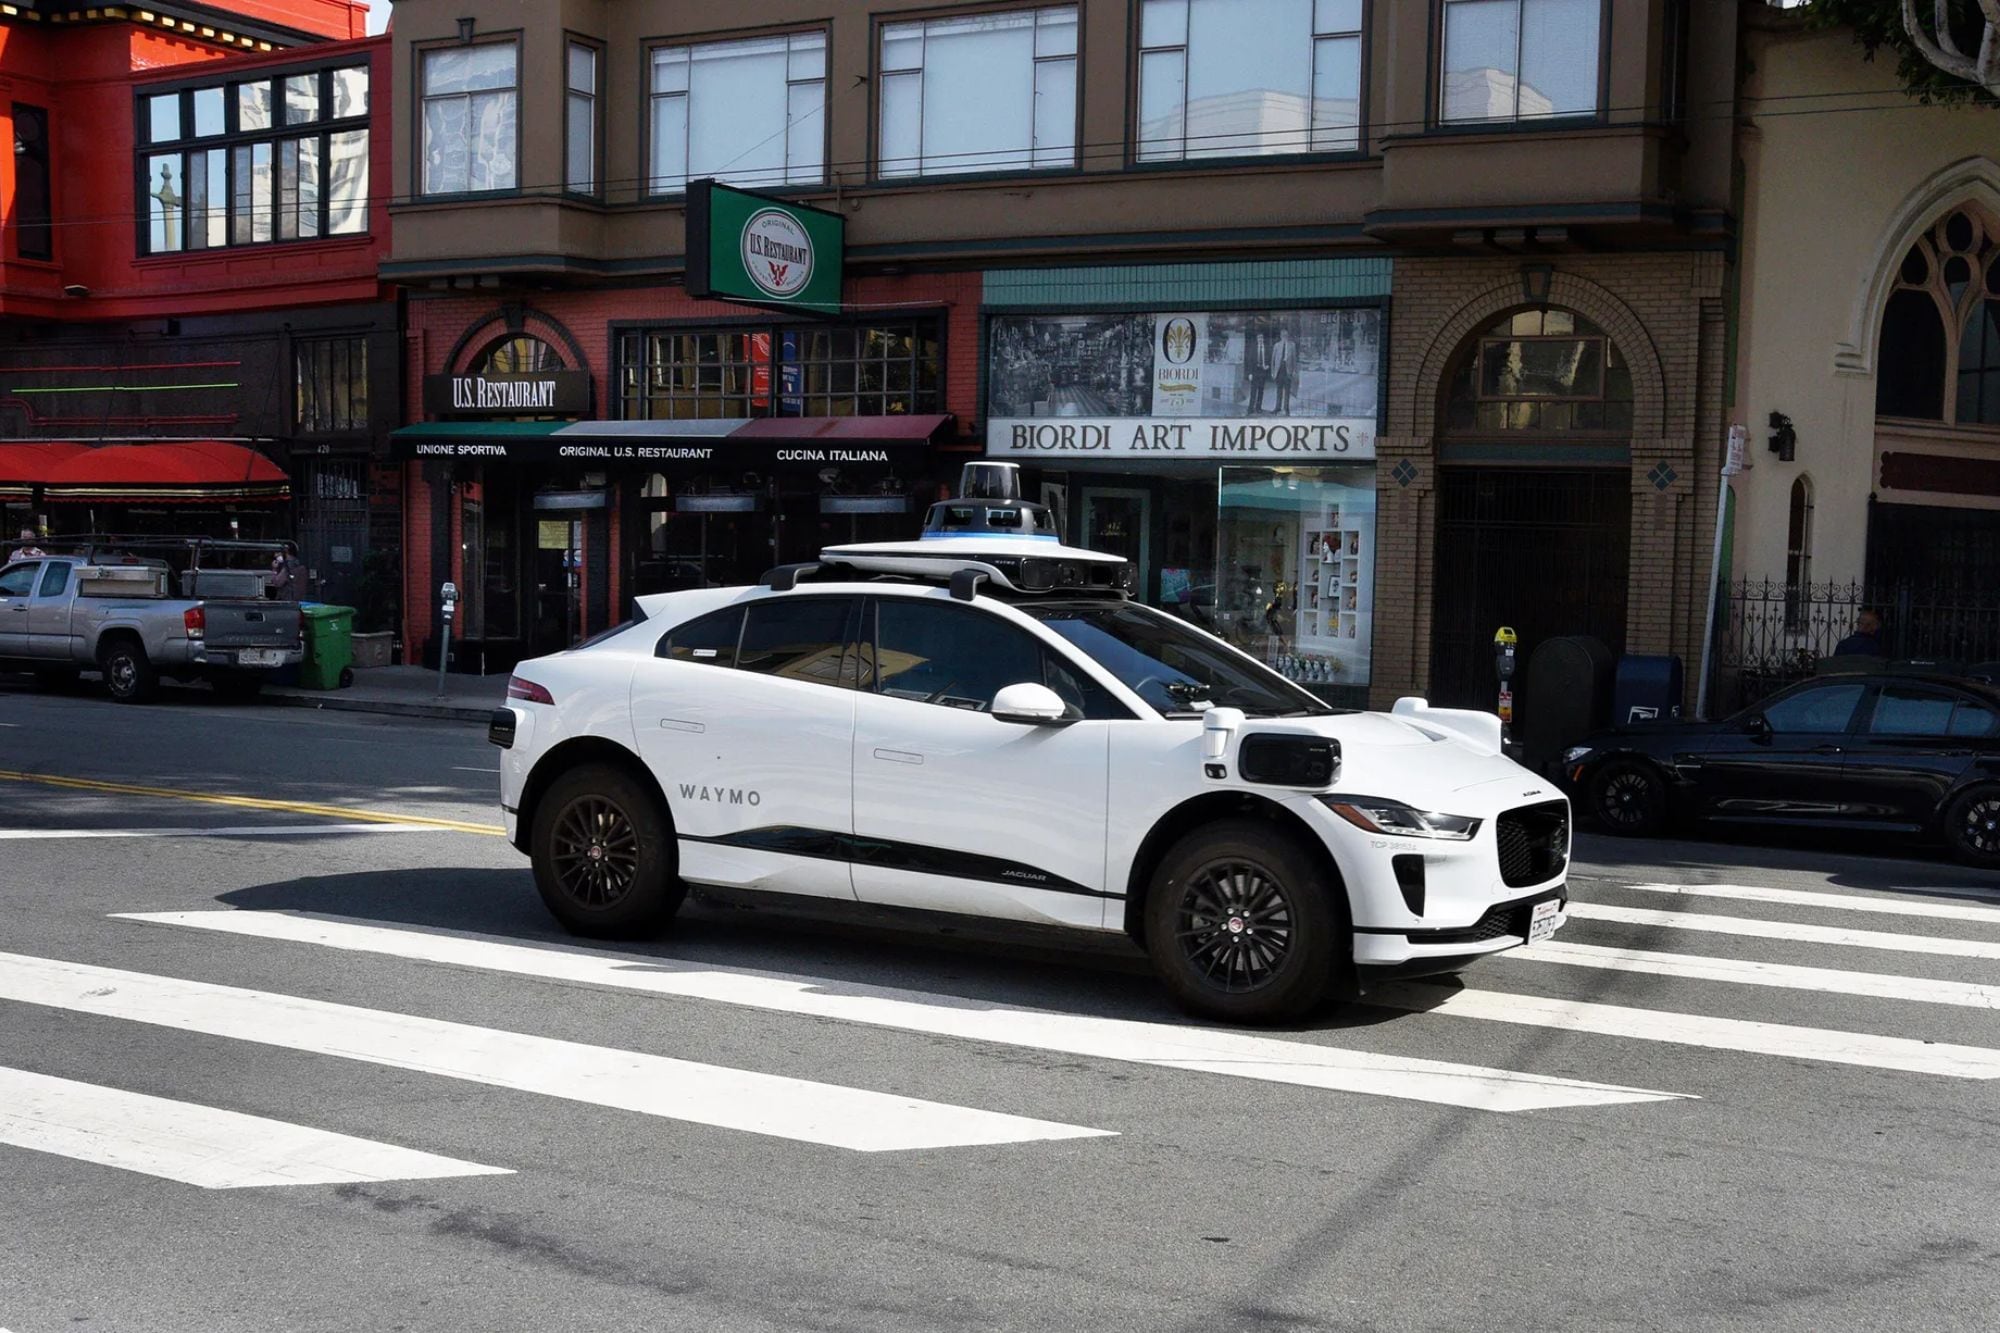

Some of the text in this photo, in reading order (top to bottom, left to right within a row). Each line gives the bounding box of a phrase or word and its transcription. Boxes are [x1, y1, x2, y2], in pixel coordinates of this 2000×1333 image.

[762, 219, 795, 236] ORIGINAL
[750, 233, 807, 265] U.S. RESTAURANT
[1158, 367, 1199, 380] BIORDI
[453, 376, 556, 408] U.S. RESTAURANT
[1010, 424, 1351, 452] BIORDI ART IMPORTS
[416, 444, 507, 456] UNIONE SPORTIVA
[559, 445, 713, 459] ORIGINAL U.S. RESTAURANT
[776, 449, 888, 462] CUCINA ITALIANA
[679, 783, 761, 806] WAYMO
[1370, 839, 1388, 850] TCP
[1001, 870, 1047, 881] JAGUAR
